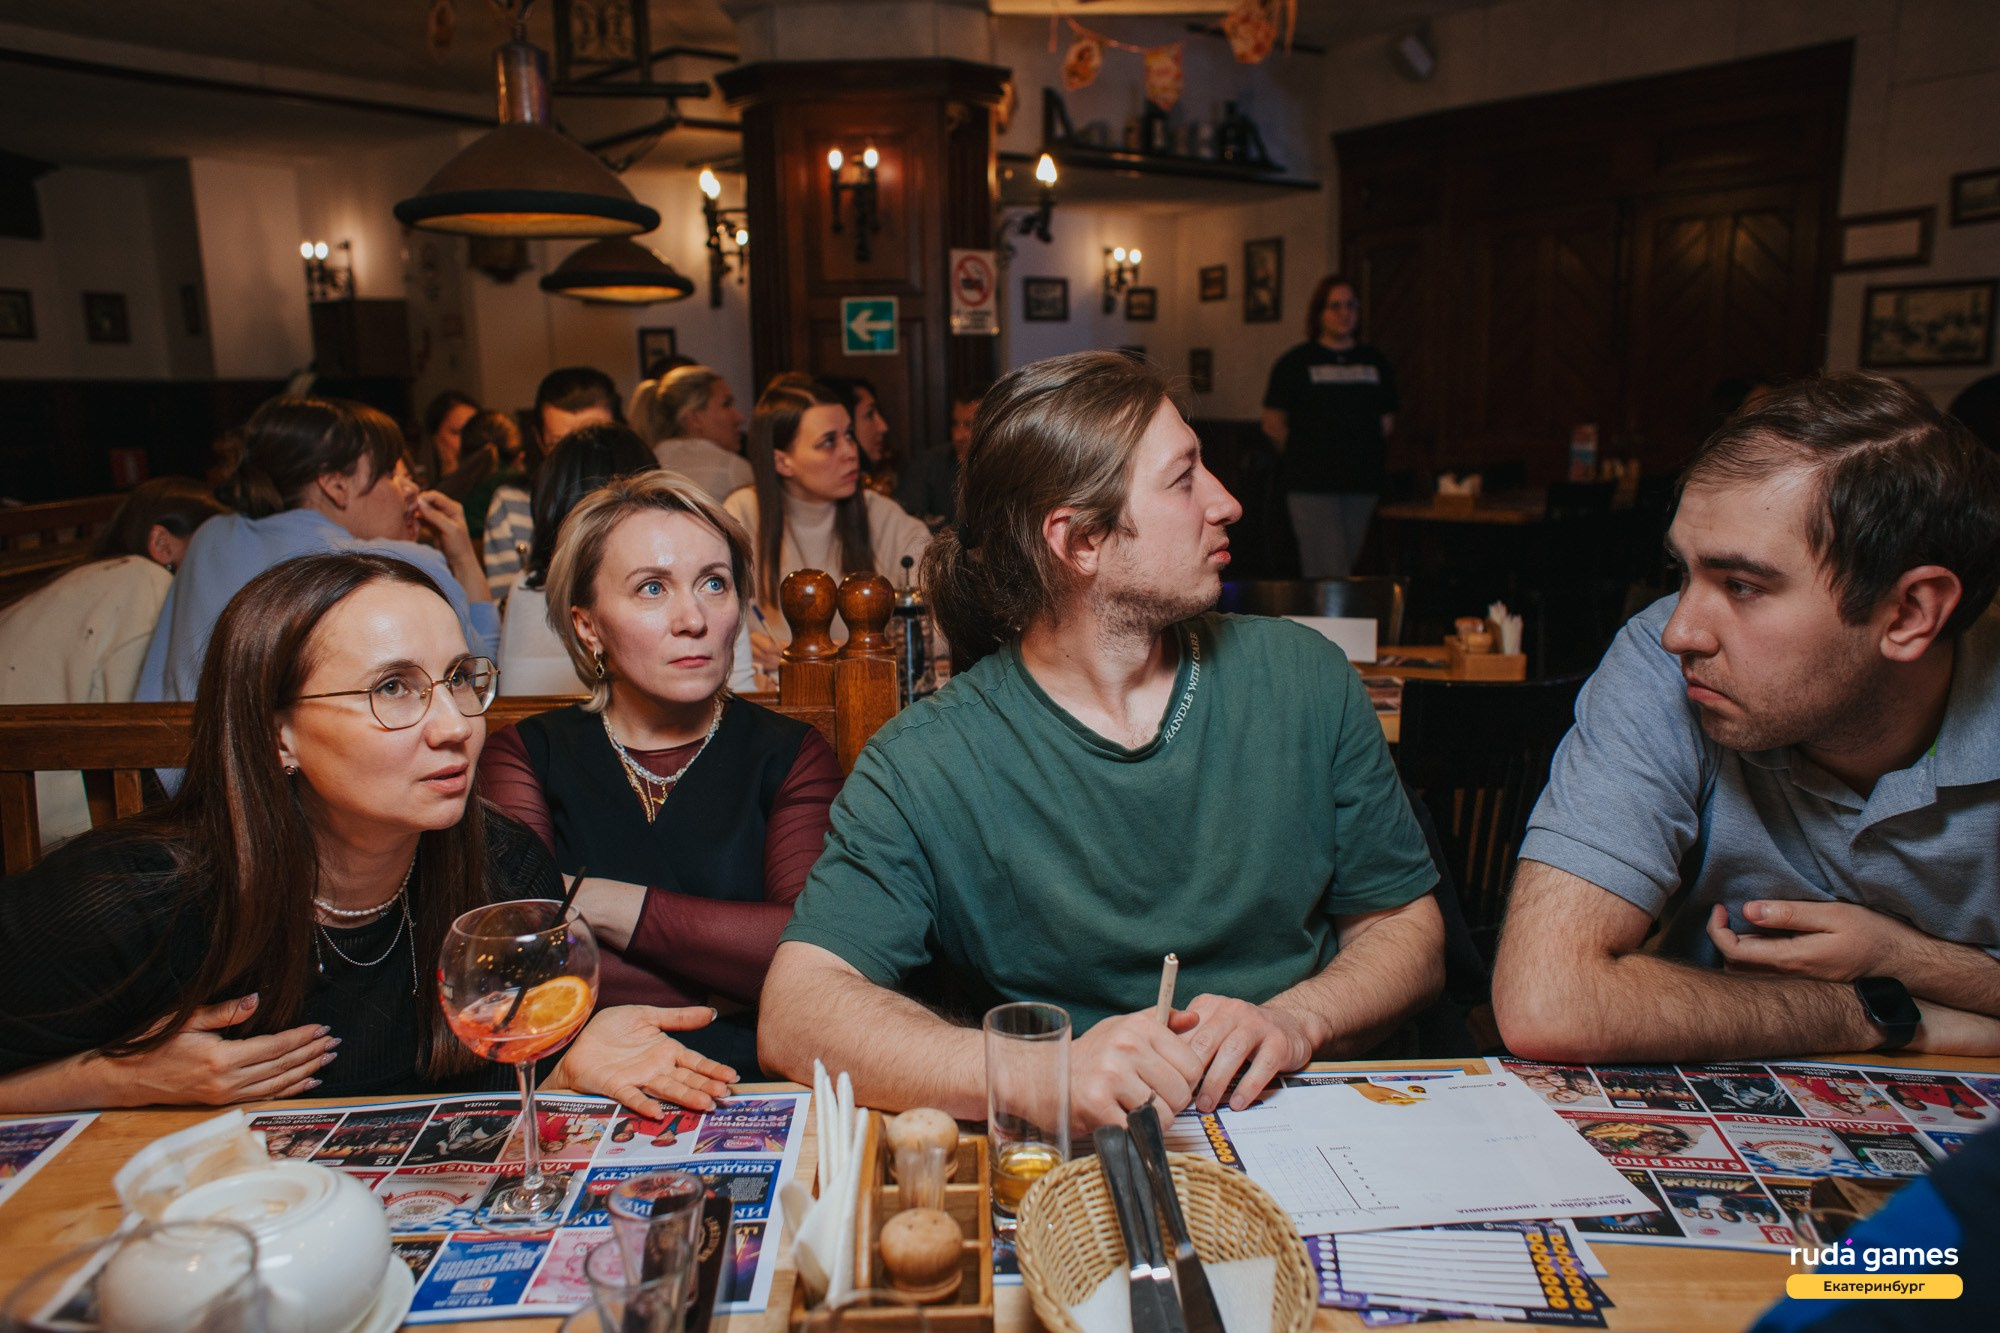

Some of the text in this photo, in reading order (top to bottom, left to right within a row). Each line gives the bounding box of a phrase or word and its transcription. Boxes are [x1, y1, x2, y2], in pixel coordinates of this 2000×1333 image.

[1164, 632, 1200, 743] HANDLE WITH CARE
[540, 1101, 607, 1109] ИМЕНИННИКА
[735, 1114, 788, 1122] РЕТРО
[1732, 1115, 1898, 1131] MAXIMILIANS.RU
[373, 1157, 394, 1165] 15
[1650, 1158, 1664, 1166] В
[1664, 1159, 1724, 1170] ЛАНЧ
[1728, 1162, 1742, 1170] 6
[414, 1162, 572, 1174] MAMILIANS.RU
[1660, 1178, 1756, 1192] Мираж
[1550, 1198, 1632, 1208] Мозгобойня
[1770, 1232, 1793, 1244] 19
